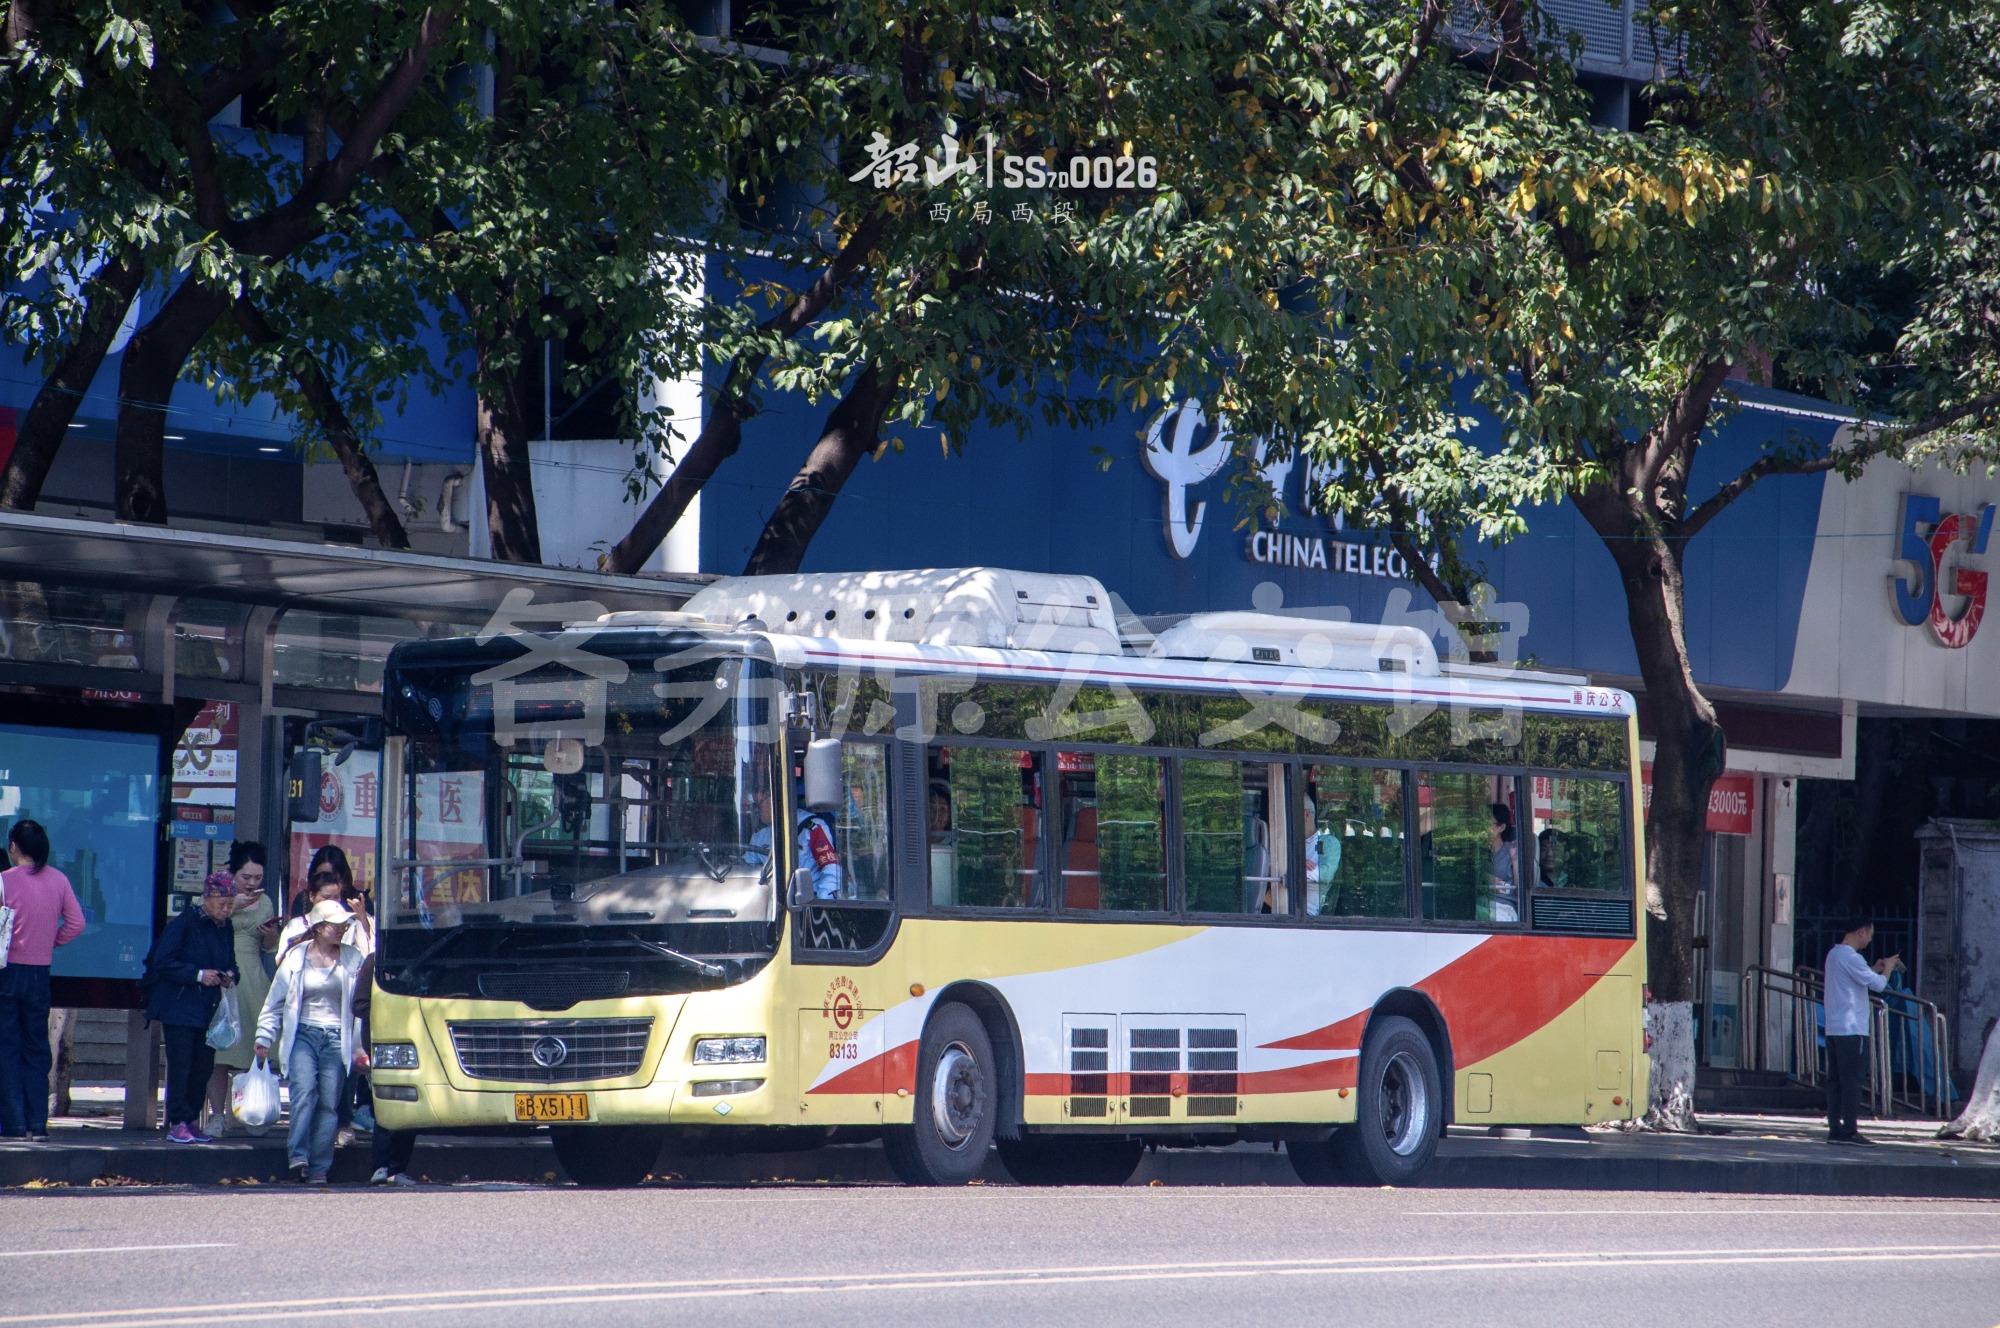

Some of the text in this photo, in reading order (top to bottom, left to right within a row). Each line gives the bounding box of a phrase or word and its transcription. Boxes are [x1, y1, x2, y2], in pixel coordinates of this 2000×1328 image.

[1252, 531, 1328, 570] CHINA
[1573, 690, 1622, 707] 重庆公交
[829, 1043, 857, 1060] 83133
